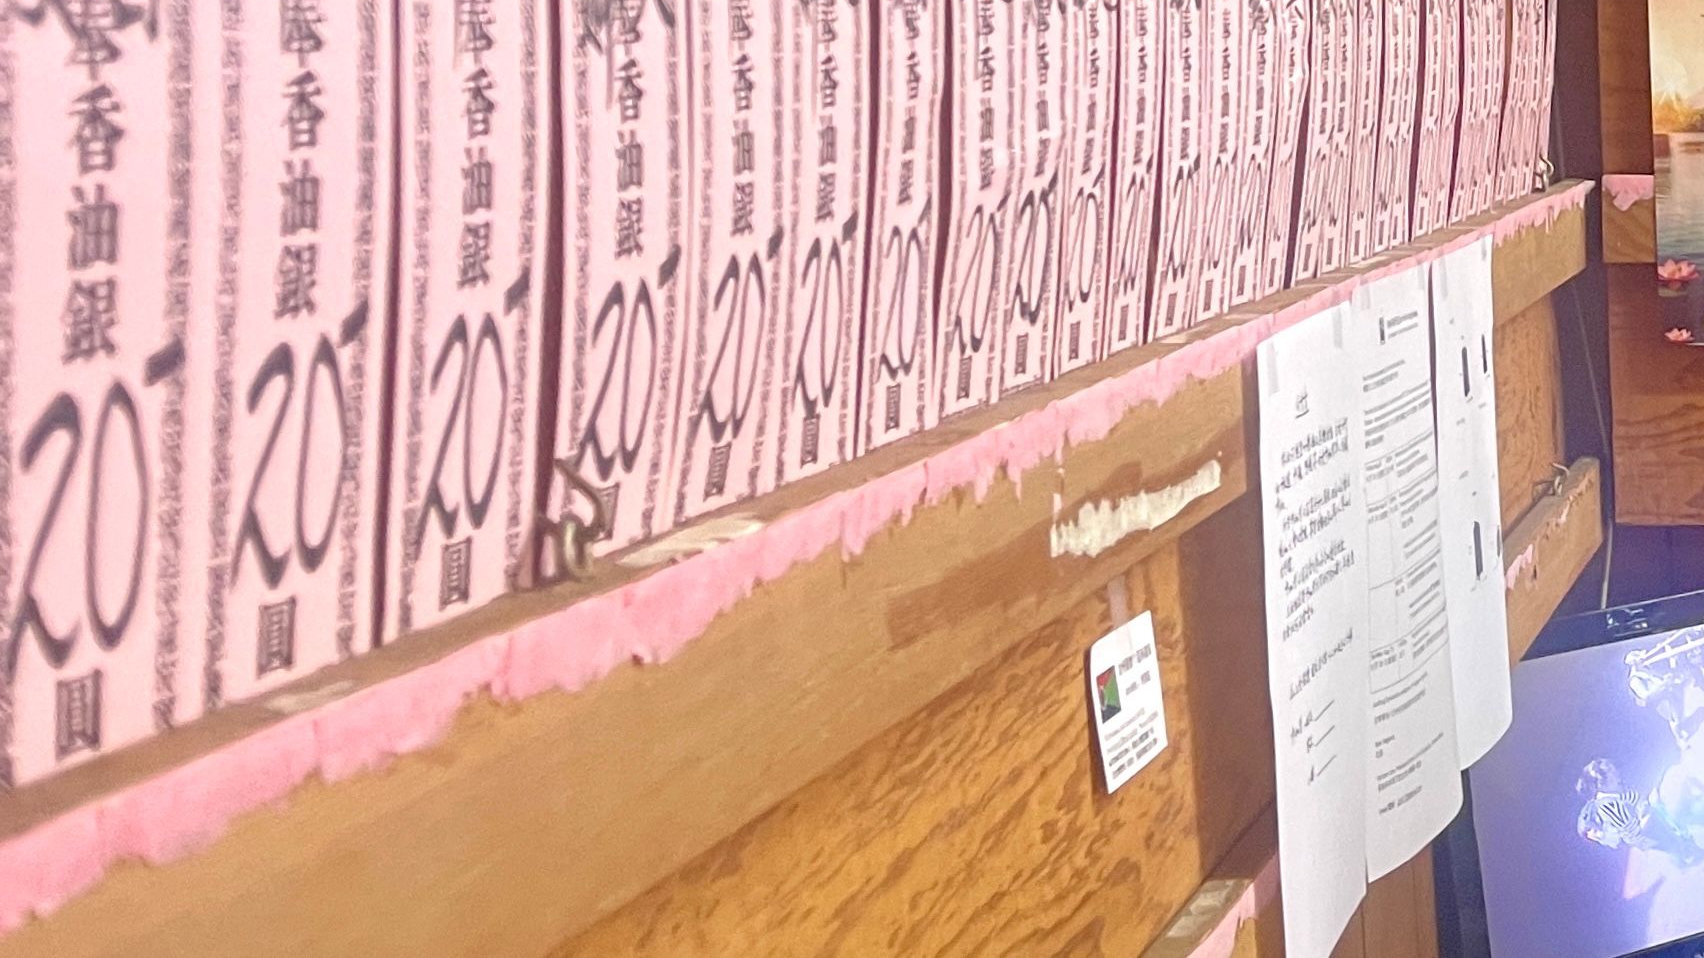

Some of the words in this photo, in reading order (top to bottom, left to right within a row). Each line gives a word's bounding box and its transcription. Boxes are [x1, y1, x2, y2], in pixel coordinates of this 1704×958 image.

[580, 277, 658, 482] 20
[692, 253, 766, 445] 20
[792, 236, 845, 416] 20
[231, 332, 350, 591] 20
[415, 310, 509, 564] 20
